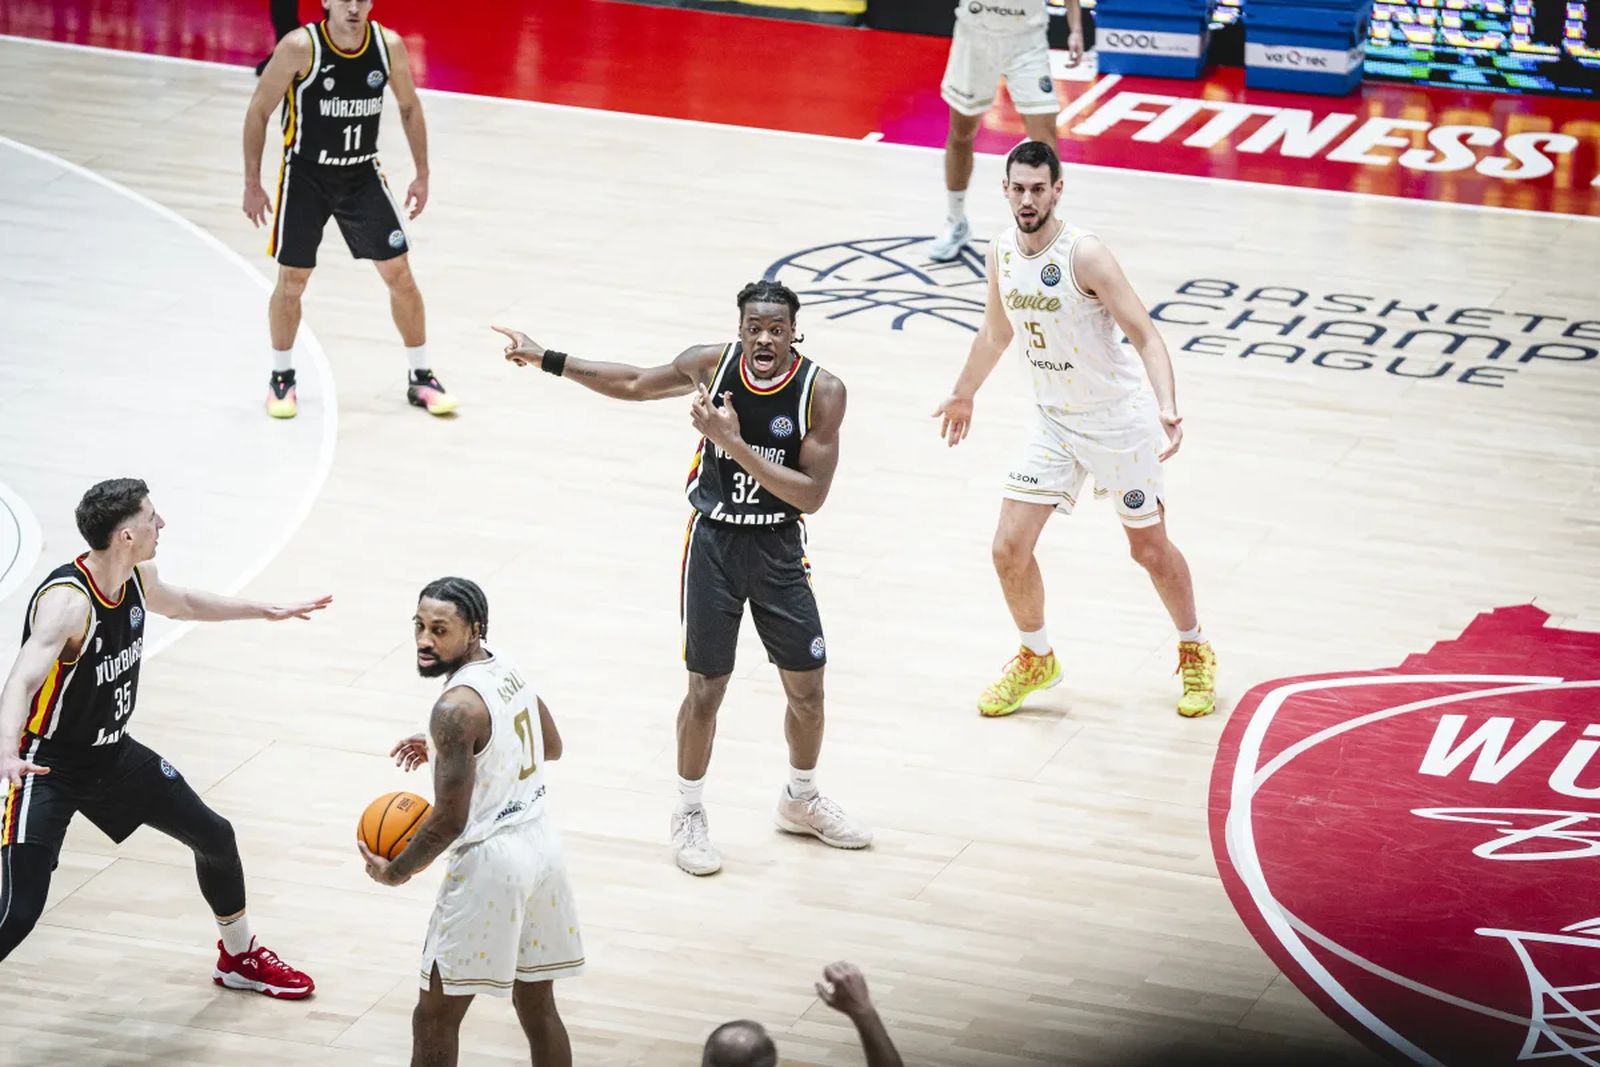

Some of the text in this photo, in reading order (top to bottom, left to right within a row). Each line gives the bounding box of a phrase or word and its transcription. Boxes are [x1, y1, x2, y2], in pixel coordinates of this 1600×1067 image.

[343, 124, 362, 151] 11
[1073, 91, 1578, 179] FITNESS
[1148, 301, 1599, 363] CHAMP
[1030, 360, 1074, 371] VEOLIA
[1121, 335, 1519, 388] EAGUE
[731, 472, 760, 504] 32
[114, 680, 132, 721] 35
